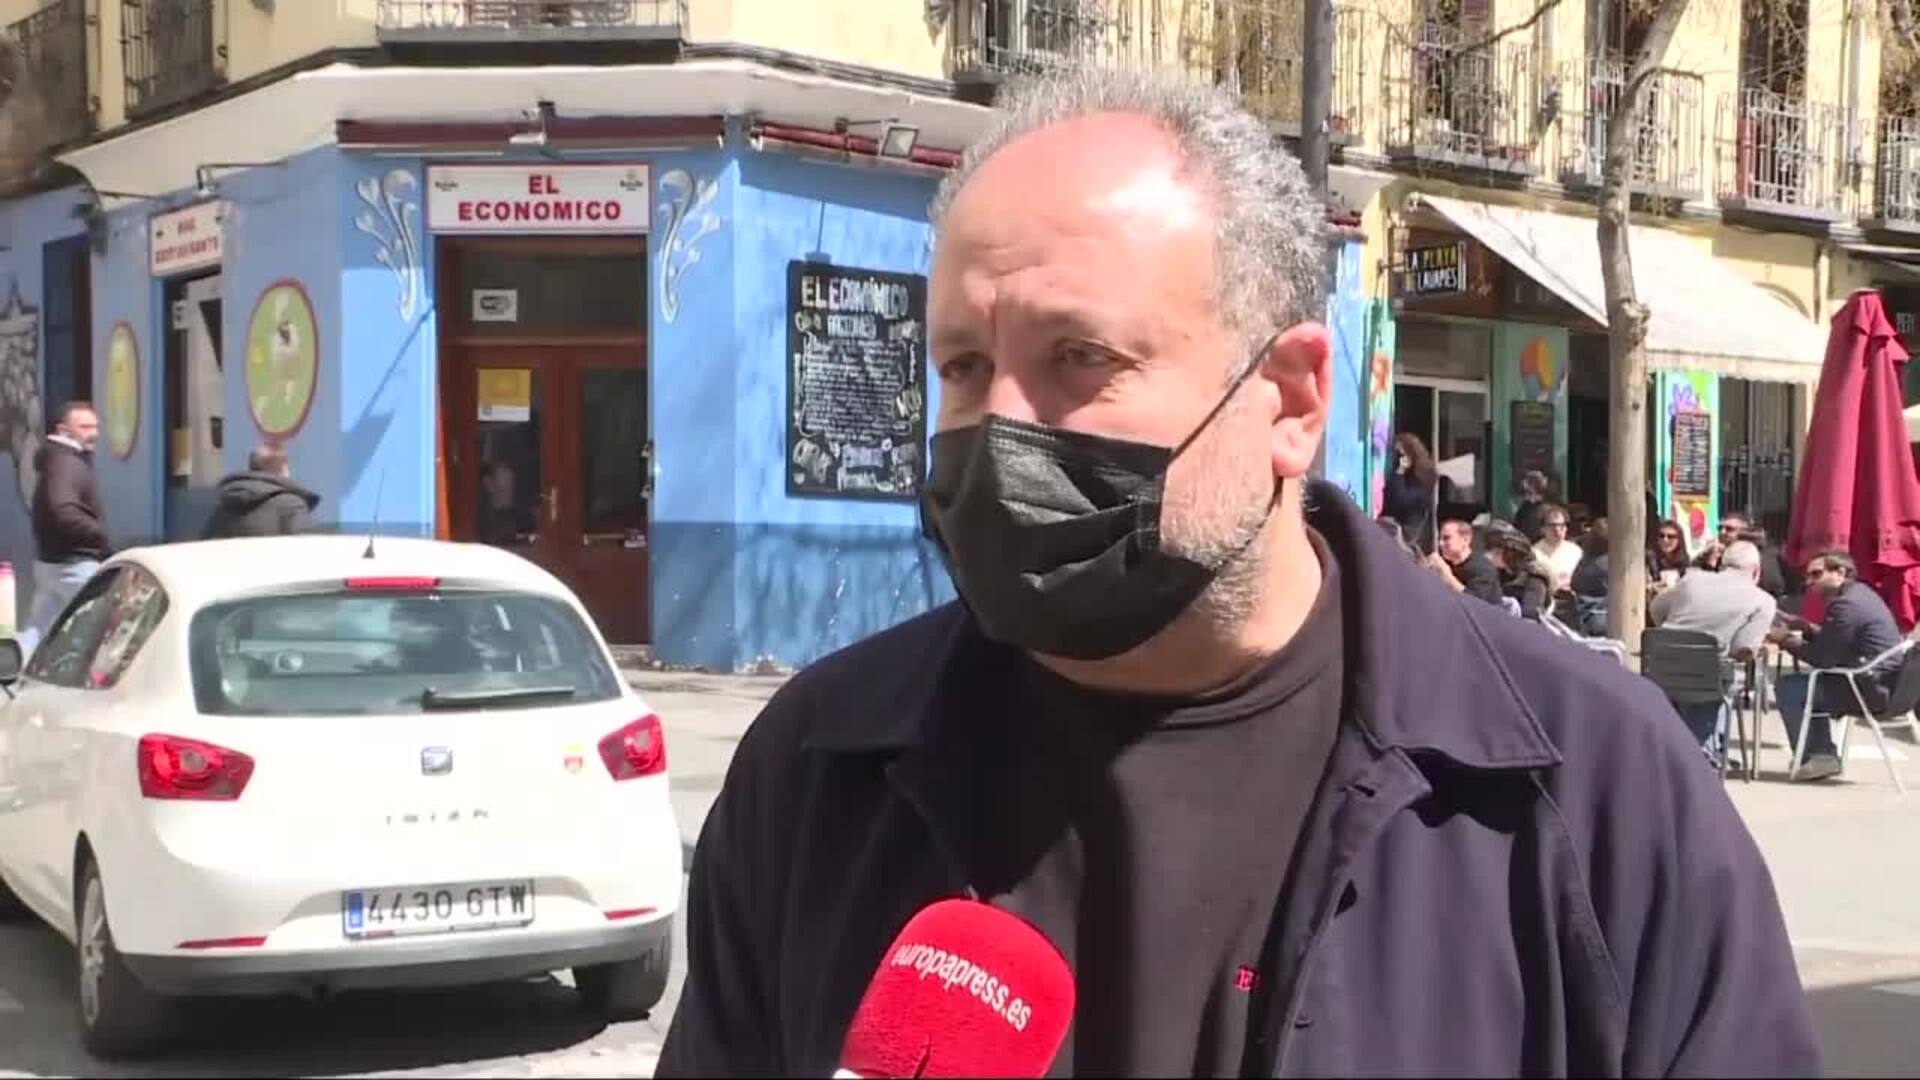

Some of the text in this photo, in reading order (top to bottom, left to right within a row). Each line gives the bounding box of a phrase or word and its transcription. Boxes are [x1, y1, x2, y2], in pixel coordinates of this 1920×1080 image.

[528, 174, 561, 195] EL
[457, 200, 622, 222] ECONOMICO
[801, 275, 828, 309] EL
[367, 884, 527, 924] 4430 GTW
[891, 943, 1032, 1032] europapress.es
